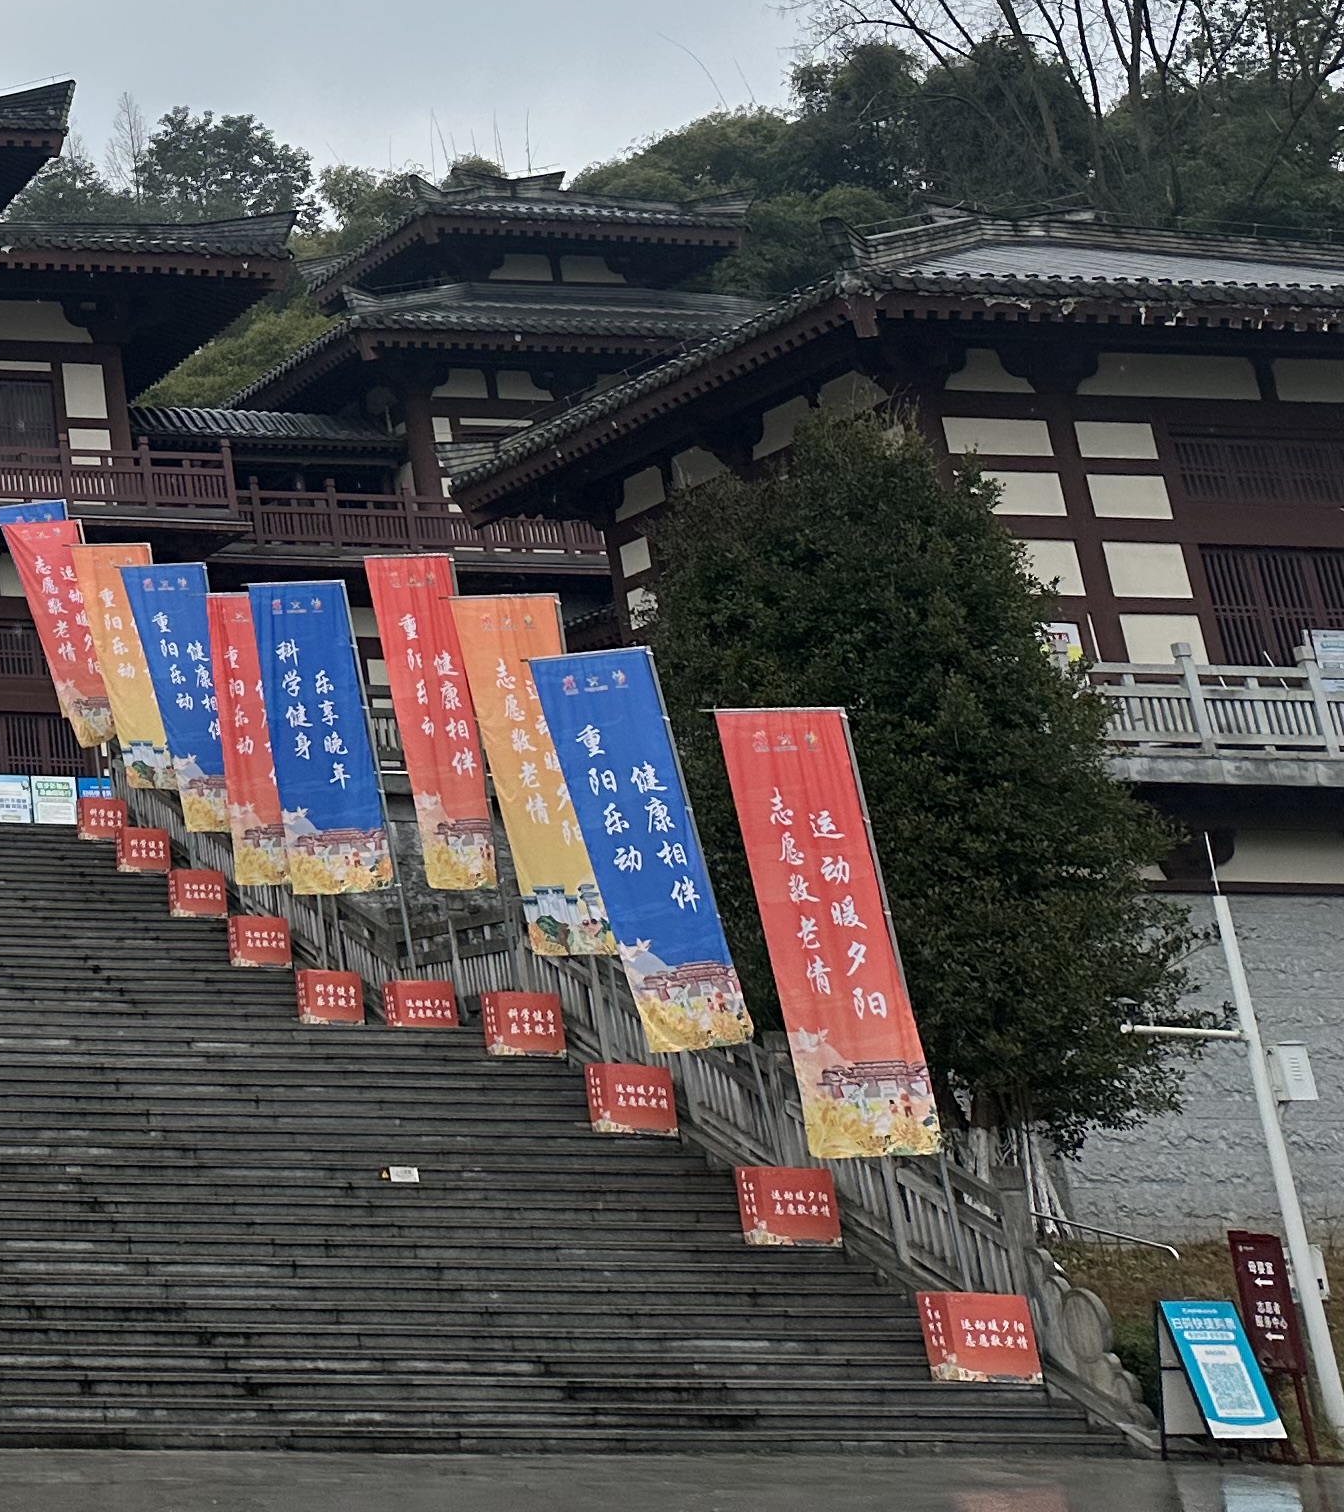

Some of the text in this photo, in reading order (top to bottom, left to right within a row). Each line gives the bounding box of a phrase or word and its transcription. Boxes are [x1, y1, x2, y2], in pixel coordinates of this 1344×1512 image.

[34, 555, 78, 663] 志愿敬老情
[98, 587, 136, 679] 重阳乐动
[152, 611, 195, 711] 重阳乐动
[223, 645, 255, 756] 重阳乐动
[274, 637, 314, 761] 科学健身
[314, 668, 352, 791] 乐享晚年
[433, 649, 478, 779] 健康相伴
[495, 657, 551, 825] 志愿敬老情
[576, 723, 643, 874] 重阳乐动
[630, 760, 701, 913] 健康相伴
[769, 786, 831, 996] 志愿敬老情
[807, 809, 888, 1020] 运动暖夕阳
[960, 1318, 1025, 1333] 运动暖夕阳
[965, 1332, 1029, 1350] 志愿敬老情
